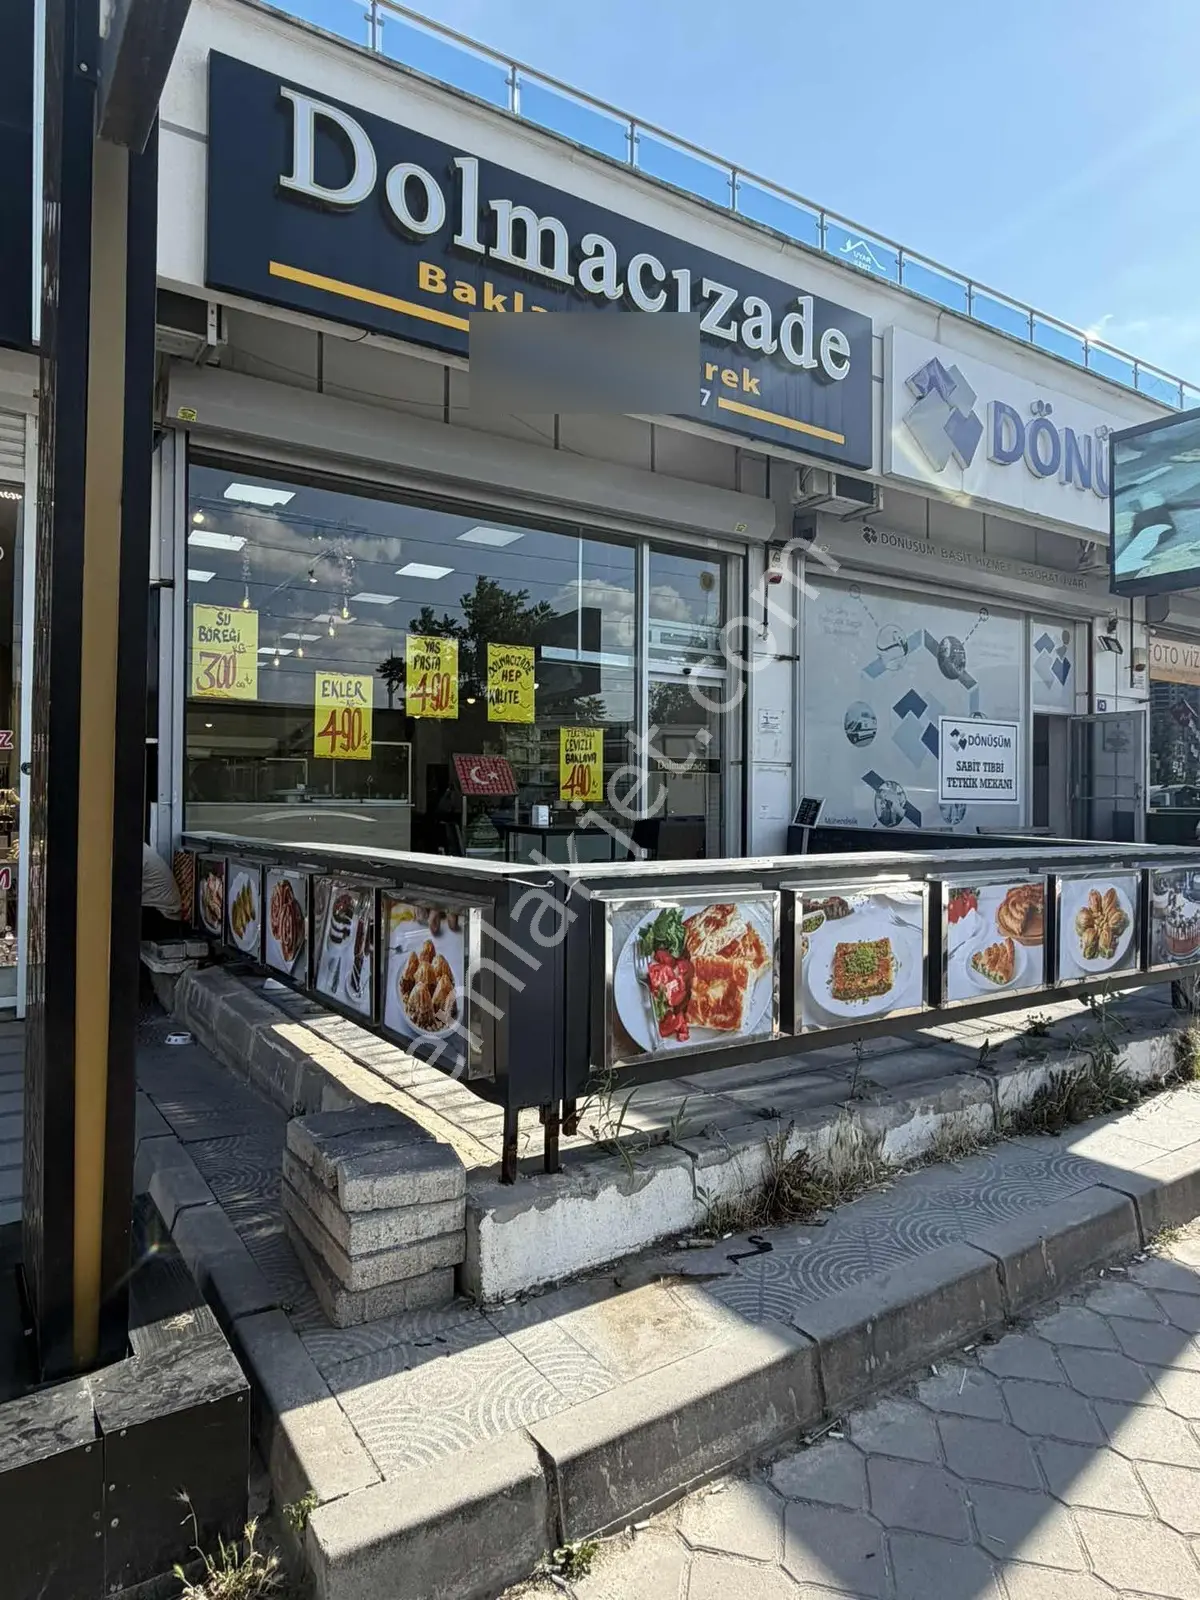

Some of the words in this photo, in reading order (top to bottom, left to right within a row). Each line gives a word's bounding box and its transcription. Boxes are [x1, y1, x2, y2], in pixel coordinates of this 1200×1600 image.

[279, 85, 851, 382] Dolmacızade
[699, 361, 762, 396] rek
[215, 611, 231, 626] SU
[195, 651, 237, 691] 300
[413, 654, 441, 671] PASTA
[501, 669, 523, 683] HEP
[321, 679, 368, 703] EKLER
[409, 672, 451, 712] 490
[317, 707, 362, 753] 490
[967, 733, 1011, 749] DÖNÜŞÜM
[956, 759, 982, 773] SABİT
[982, 760, 1004, 773] TIBBİ
[946, 775, 978, 788] TETKİK
[979, 778, 1013, 789] MEKANI
